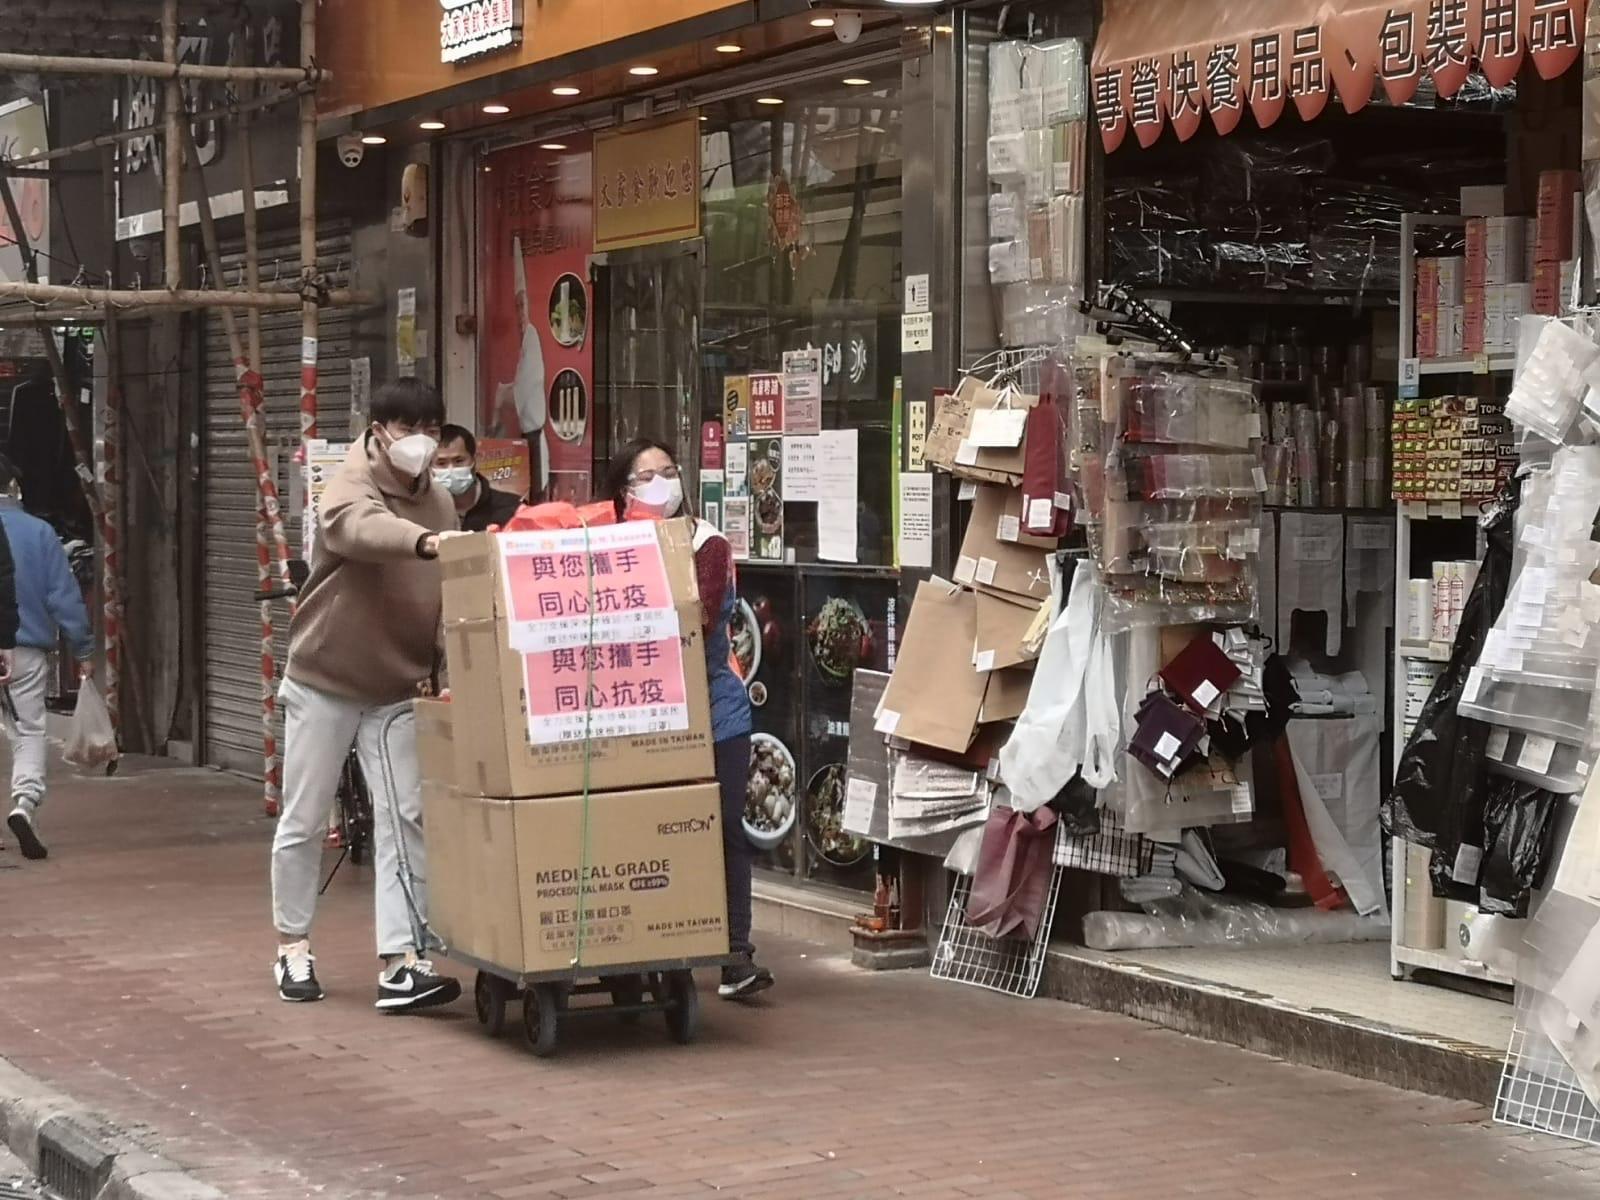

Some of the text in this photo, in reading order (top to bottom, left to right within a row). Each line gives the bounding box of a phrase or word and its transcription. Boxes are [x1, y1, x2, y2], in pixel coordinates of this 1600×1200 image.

[531, 548, 640, 580] 與您攜手
[538, 583, 650, 617] 同心抗疫
[552, 640, 661, 674] 與您攜手
[554, 677, 665, 711] 同心抗疫
[631, 733, 705, 748] MADE IN TAIWAN
[536, 858, 671, 885] MEDICAL GRADE
[537, 881, 625, 899] PROCEDURAL MASK
[647, 917, 721, 931] MADE IN TAIWAN
